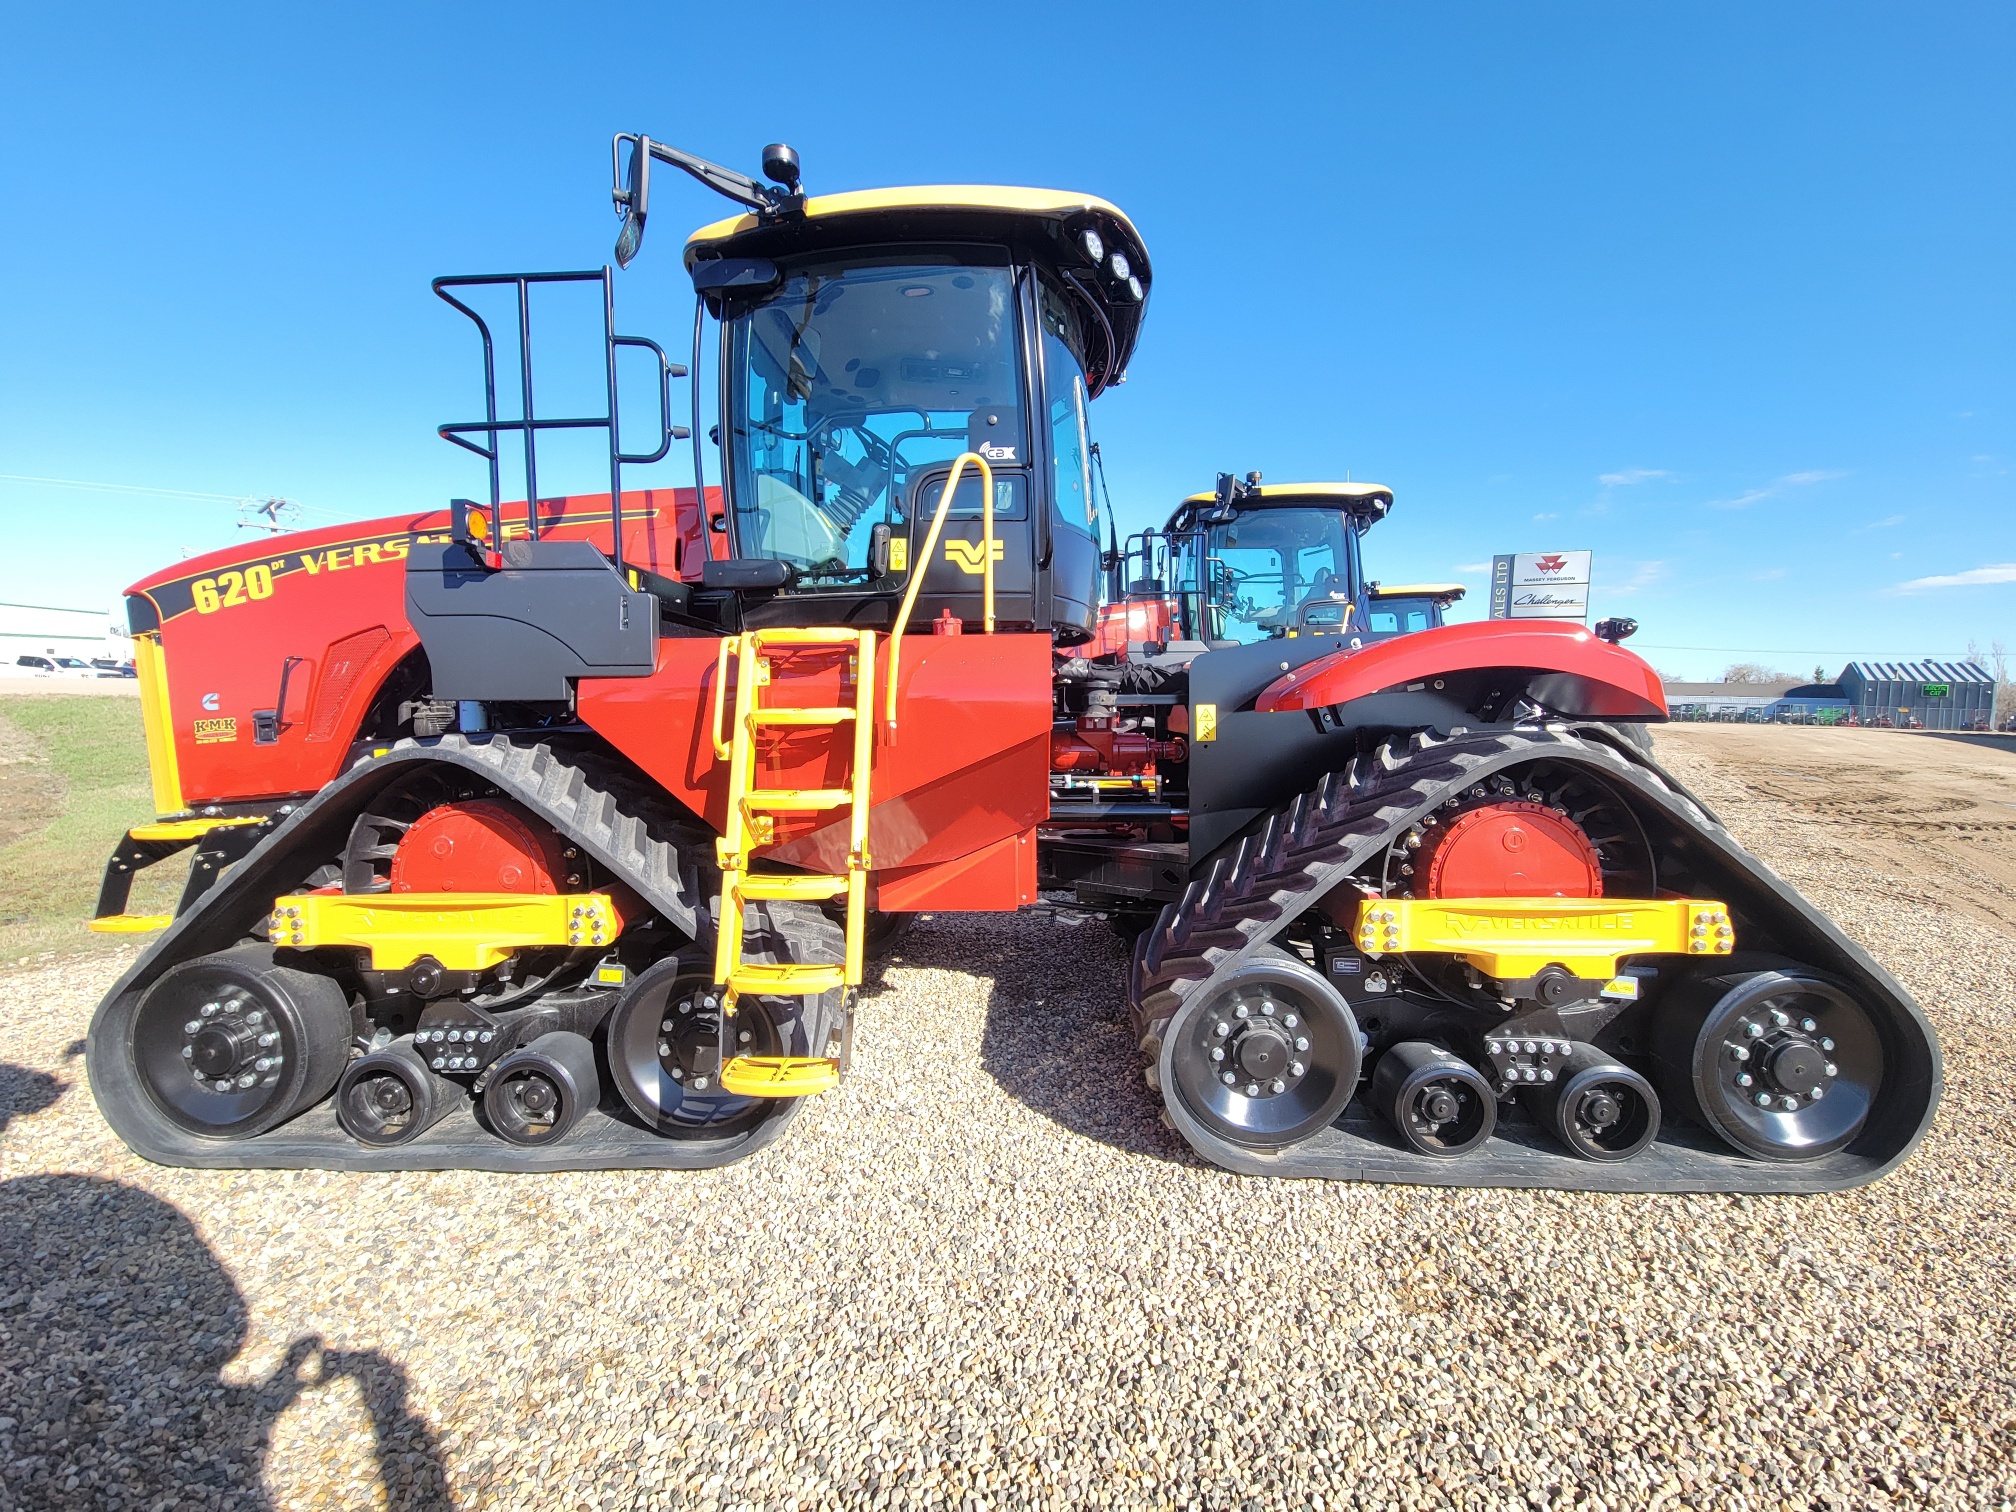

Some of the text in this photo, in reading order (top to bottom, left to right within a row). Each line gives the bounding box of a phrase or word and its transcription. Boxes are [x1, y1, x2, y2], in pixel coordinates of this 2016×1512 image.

[1497, 561, 1508, 584] LTD
[191, 564, 274, 615] 620
[271, 559, 286, 571] DT
[1513, 593, 1577, 608] Challenger
